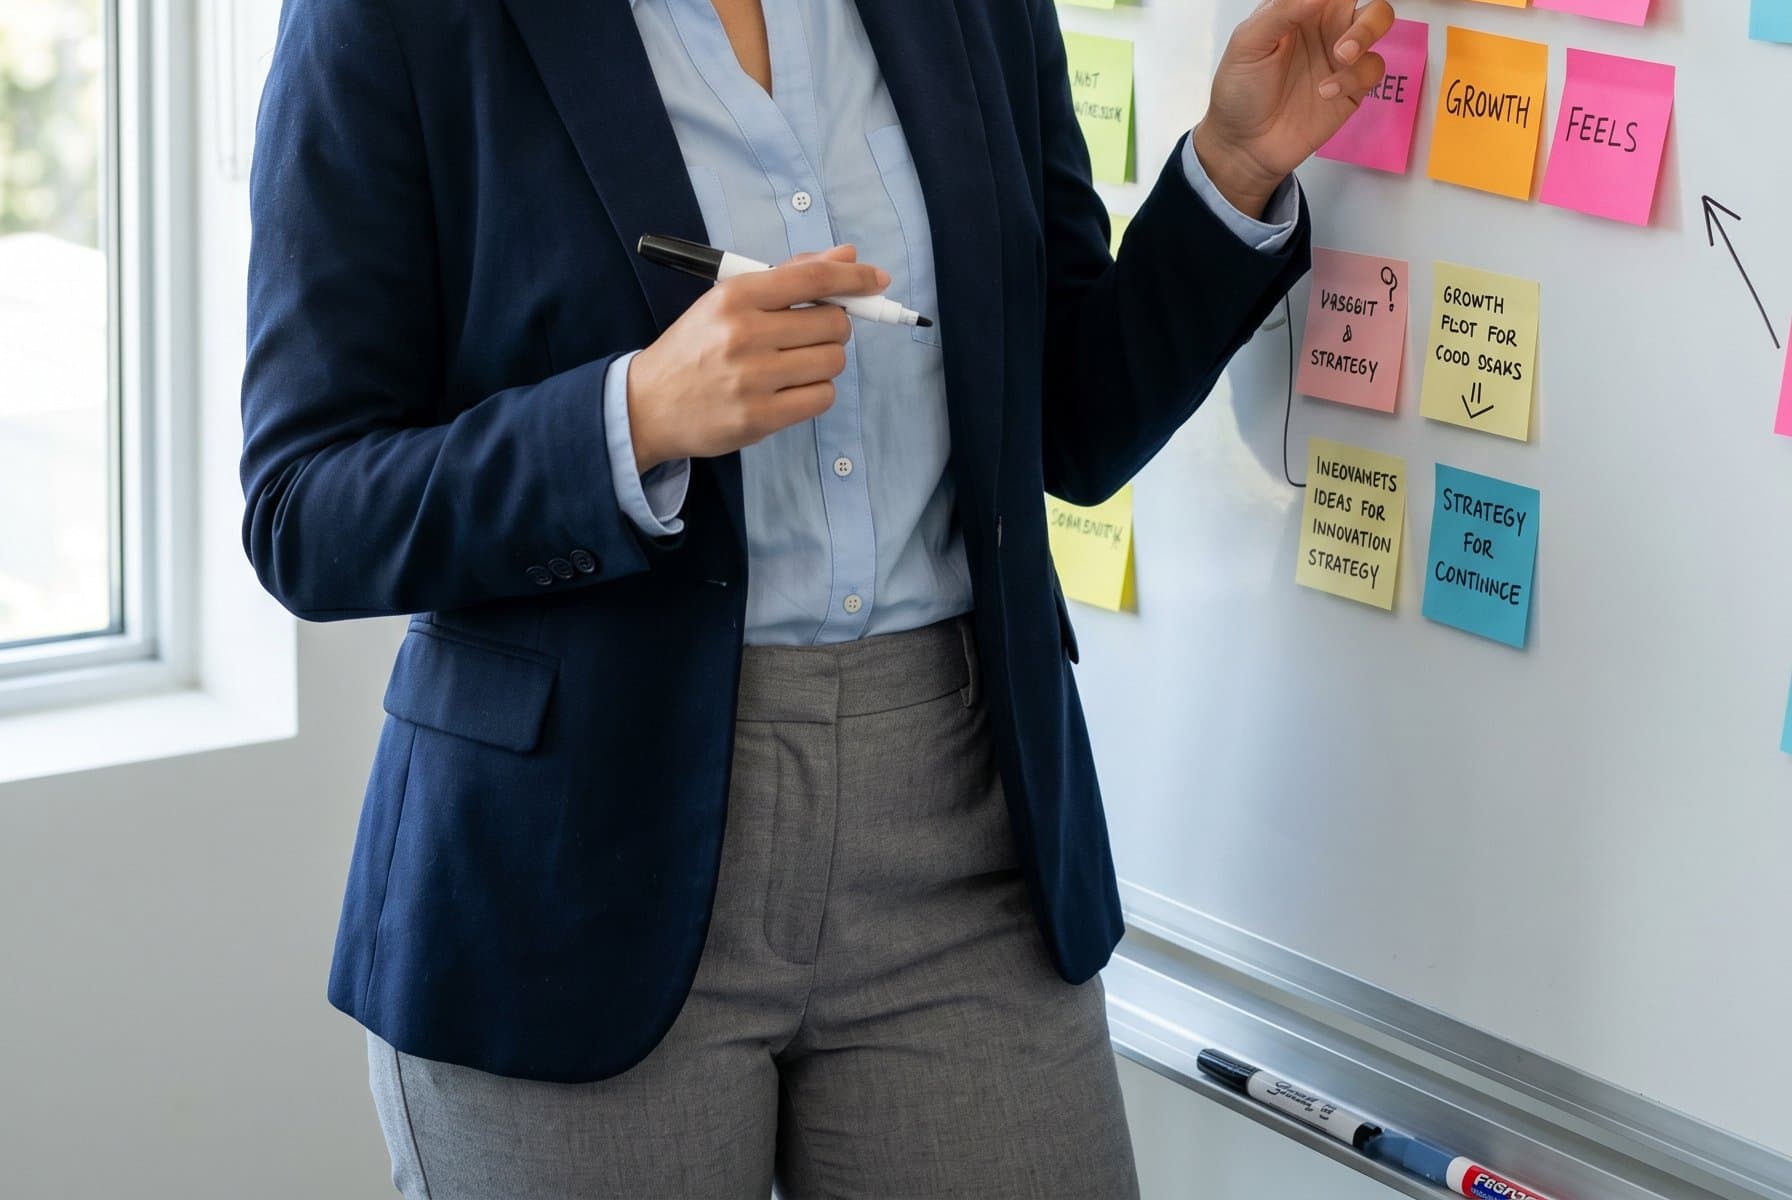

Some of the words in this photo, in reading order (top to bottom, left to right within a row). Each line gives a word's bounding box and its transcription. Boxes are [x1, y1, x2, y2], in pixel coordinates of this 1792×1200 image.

[1445, 78, 1532, 129] GROWTH
[1565, 105, 1639, 153] FEELS
[1442, 285, 1505, 315] GROWTH
[1487, 325, 1518, 348] FOR
[1310, 349, 1379, 384] STRATEGY
[1313, 487, 1353, 513] IDEAS
[1361, 500, 1387, 522] FOR
[1442, 487, 1528, 538] STRATEGY
[1312, 518, 1393, 554] INNOVATION
[1463, 531, 1495, 560] FOR
[1308, 548, 1381, 590] STRATEGY
